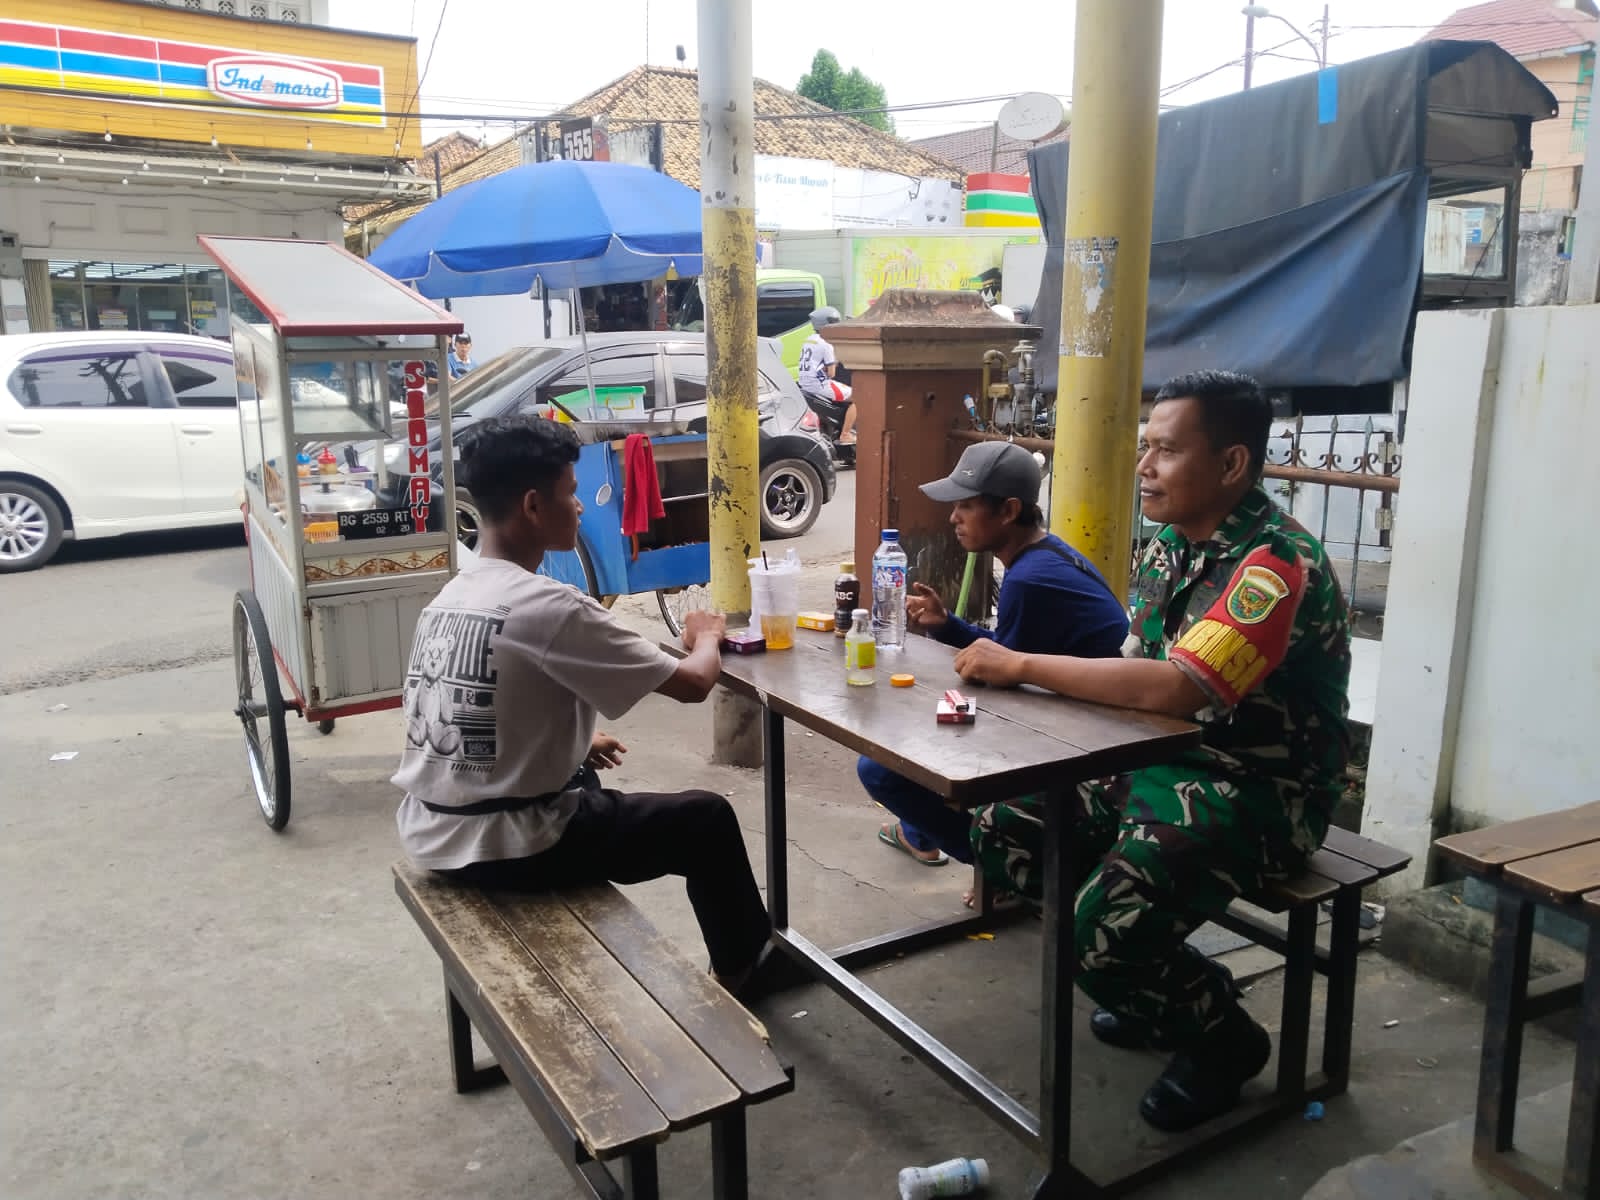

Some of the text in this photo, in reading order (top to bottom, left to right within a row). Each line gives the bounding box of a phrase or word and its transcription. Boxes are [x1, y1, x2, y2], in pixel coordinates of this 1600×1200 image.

[563, 127, 593, 161] 555
[404, 361, 432, 533] SIOMAY
[340, 511, 409, 526] BG 2559 RT
